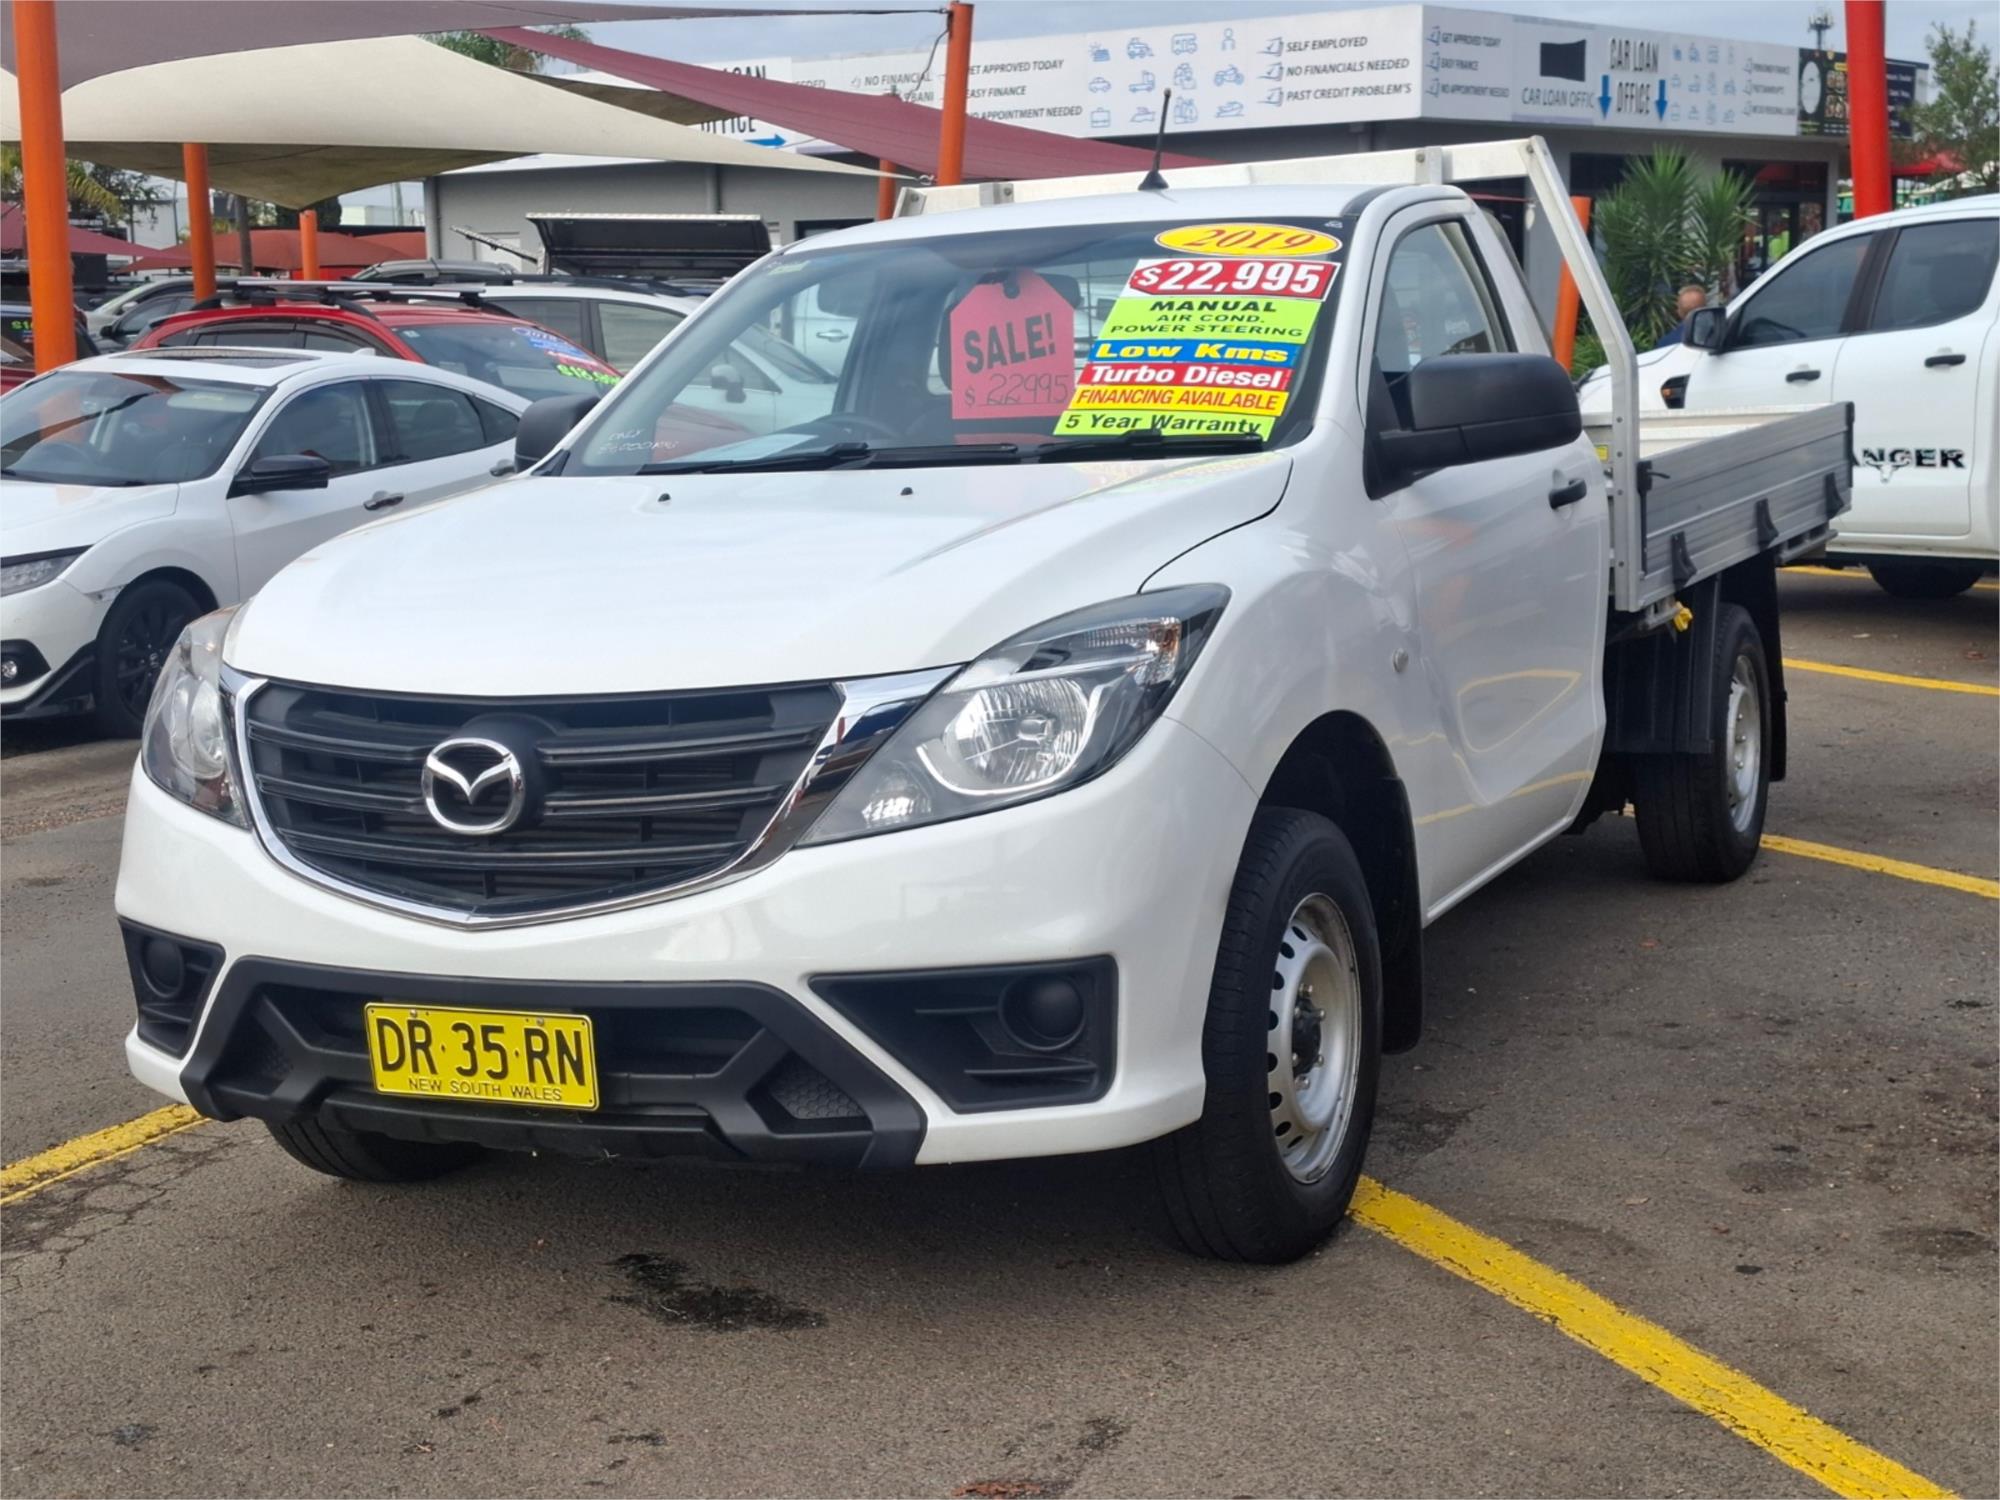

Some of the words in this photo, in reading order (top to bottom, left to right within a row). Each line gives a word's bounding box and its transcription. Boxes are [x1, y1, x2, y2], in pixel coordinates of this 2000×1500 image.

[1286, 41, 1311, 52] SELF
[1311, 37, 1368, 50] EMPLOYED
[1610, 38, 1631, 71] CAR
[1633, 41, 1660, 73] LOAN
[967, 64, 980, 74] ET
[982, 62, 1031, 74] APPROVED
[1032, 59, 1065, 71] TODAY
[1286, 66, 1302, 77] NO
[1304, 61, 1365, 75] FINANCIALS
[1367, 58, 1410, 71] NEEDED
[864, 75, 879, 86] NO
[987, 85, 1027, 97] FINANCE
[1286, 90, 1312, 101] PAST
[1313, 87, 1349, 100] CREDIT
[1352, 83, 1412, 97] PROBLEM'S
[1521, 87, 1542, 104] CAR
[1543, 88, 1568, 106] LOAN
[1616, 81, 1651, 115] OFFICE
[1046, 106, 1083, 118] NEEDED
[1184, 229, 1317, 250] 2019
[1137, 262, 1325, 293] $22,995
[1150, 301, 1277, 312] MANUAL
[1157, 314, 1192, 323] AIR
[1197, 314, 1265, 323] COND.
[1111, 325, 1185, 333] POWER
[1192, 324, 1303, 337] STEERING
[963, 312, 1055, 374] SALE!
[1095, 343, 1183, 358] Low
[1194, 343, 1288, 362] Kms
[1091, 365, 1174, 383] Turbo
[1183, 366, 1283, 388] Diesel
[1076, 389, 1175, 405] FINANCING
[1178, 390, 1279, 410] AVAILABLE
[1065, 415, 1080, 429] 5
[1090, 414, 1142, 429] Year
[1150, 415, 1263, 433] Warranty
[1852, 448, 1965, 468] NGER
[408, 1078, 442, 1091] NEW
[450, 1080, 501, 1097] SOUTH
[510, 1085, 563, 1101] WALES
